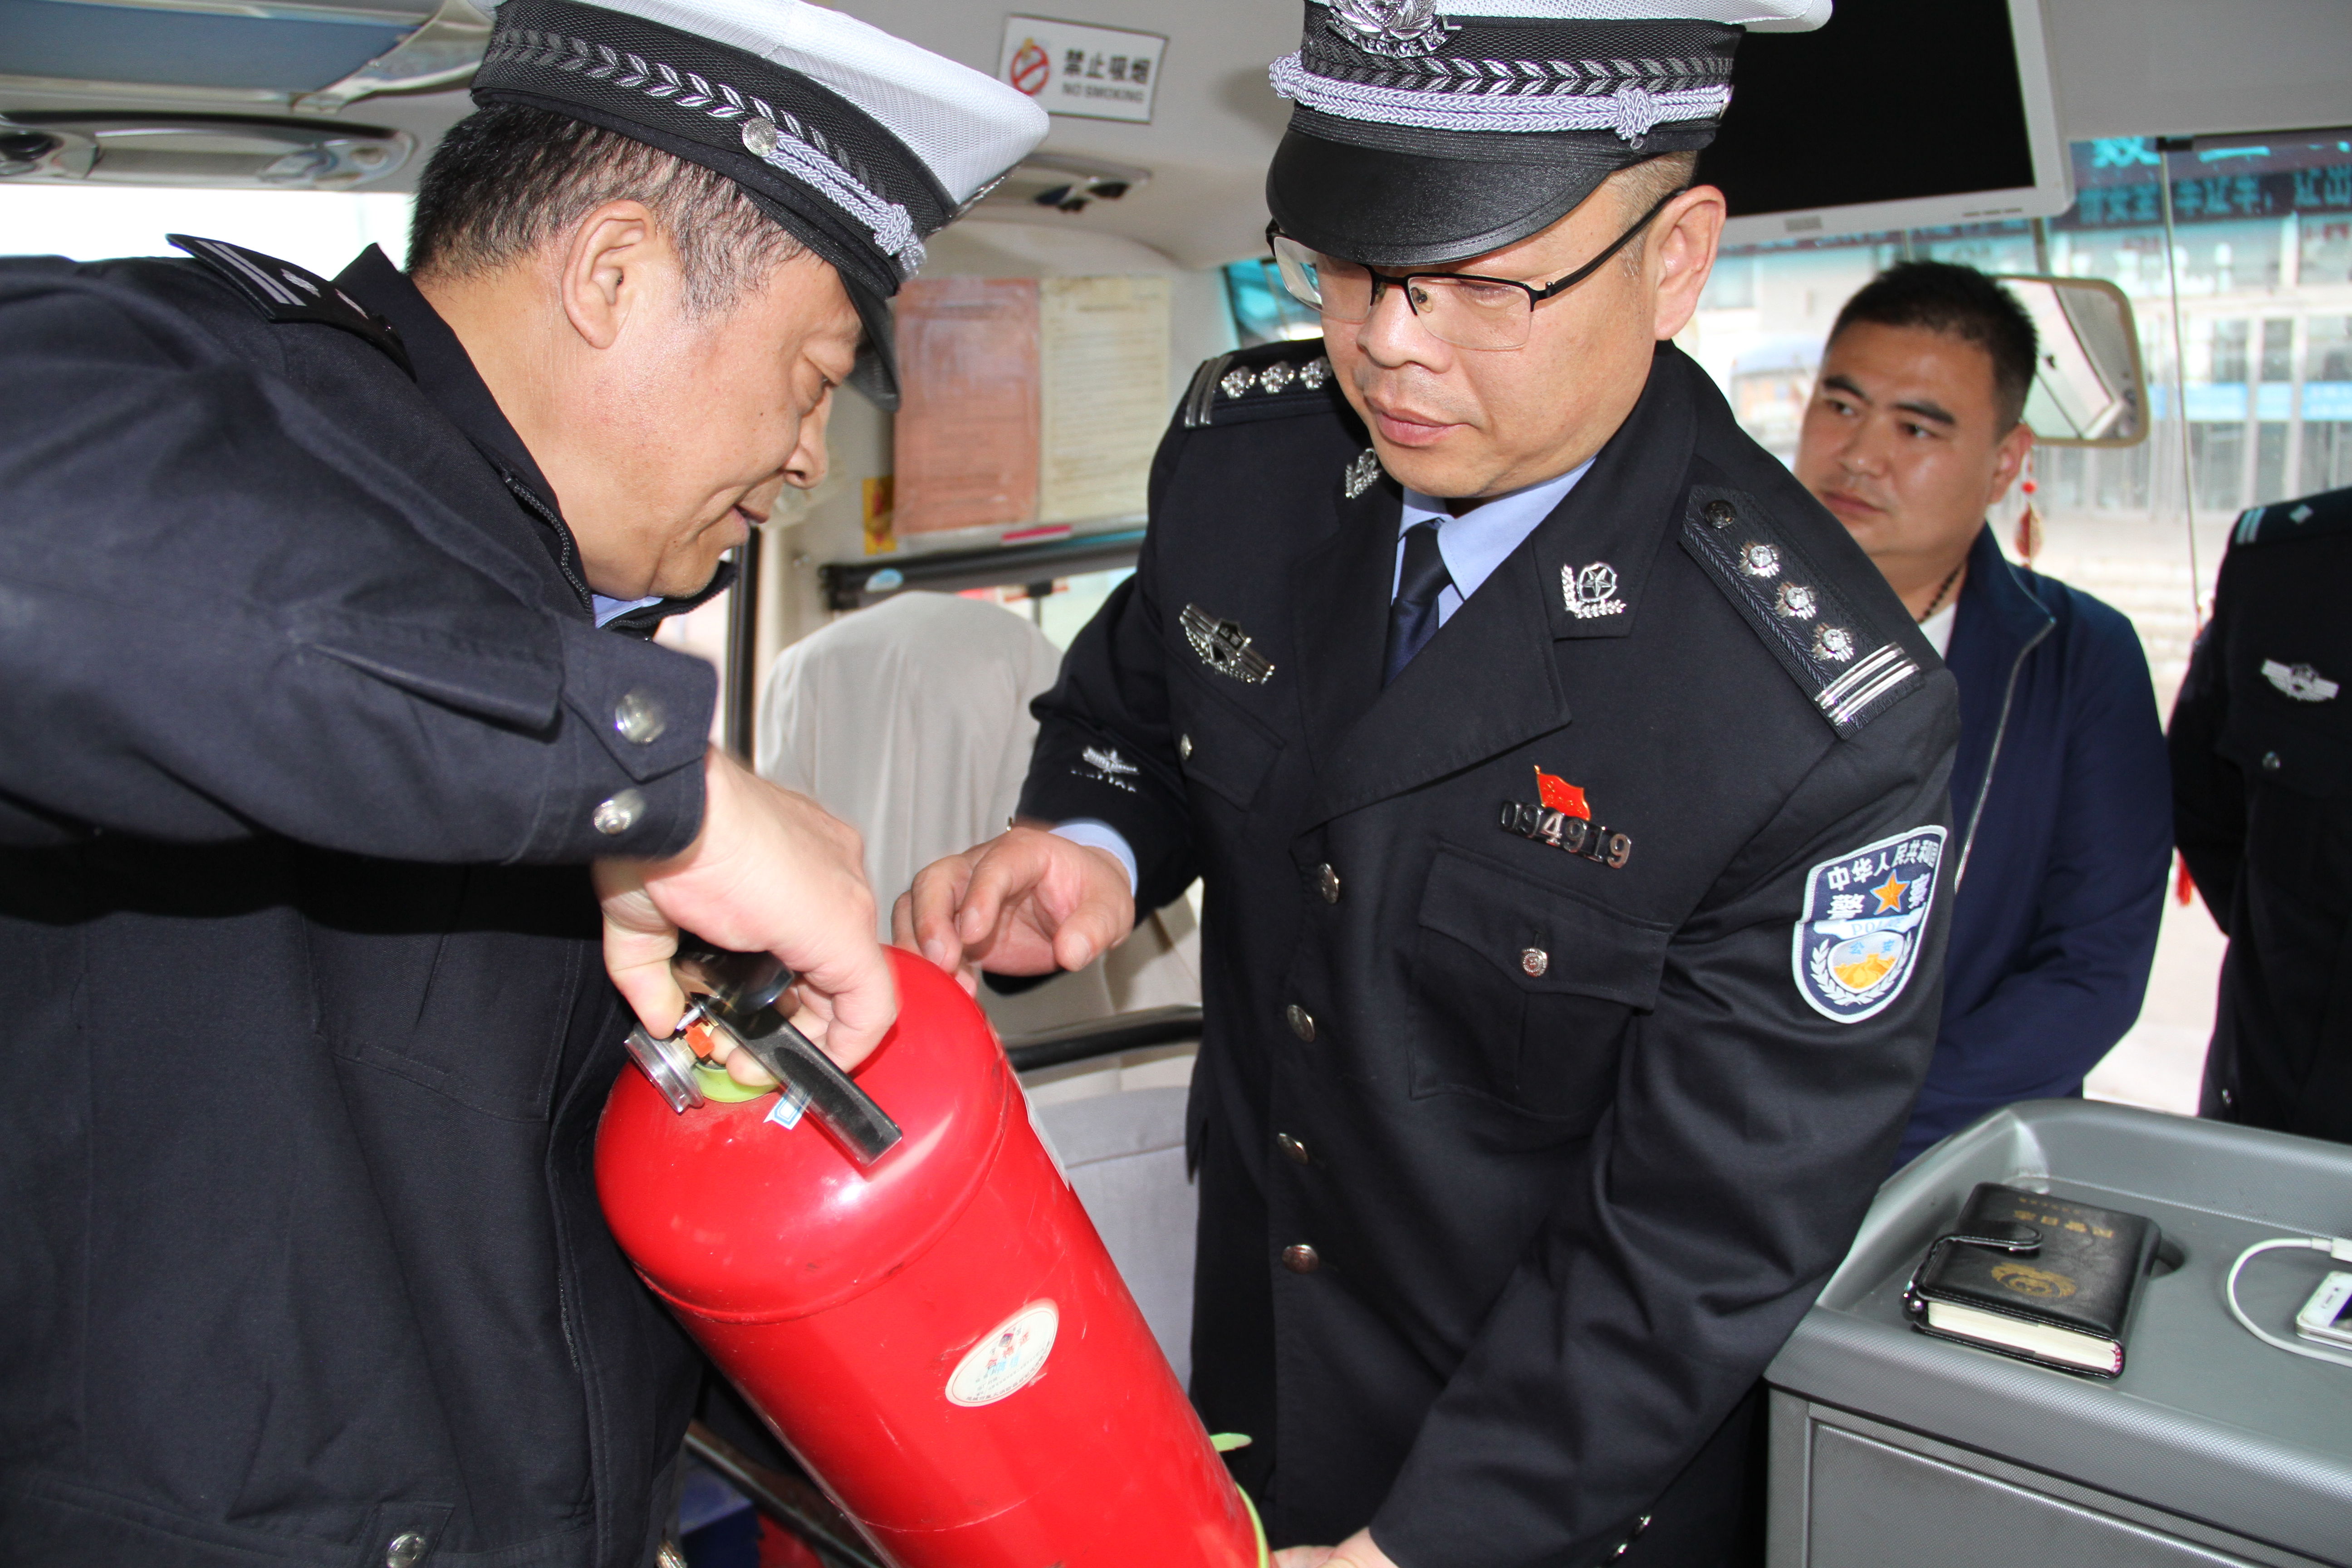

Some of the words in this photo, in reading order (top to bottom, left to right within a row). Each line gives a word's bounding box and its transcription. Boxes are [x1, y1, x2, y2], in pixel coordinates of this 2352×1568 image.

[1500, 800, 1632, 868] 094919
[1827, 839, 1939, 891] 中华人民共和国
